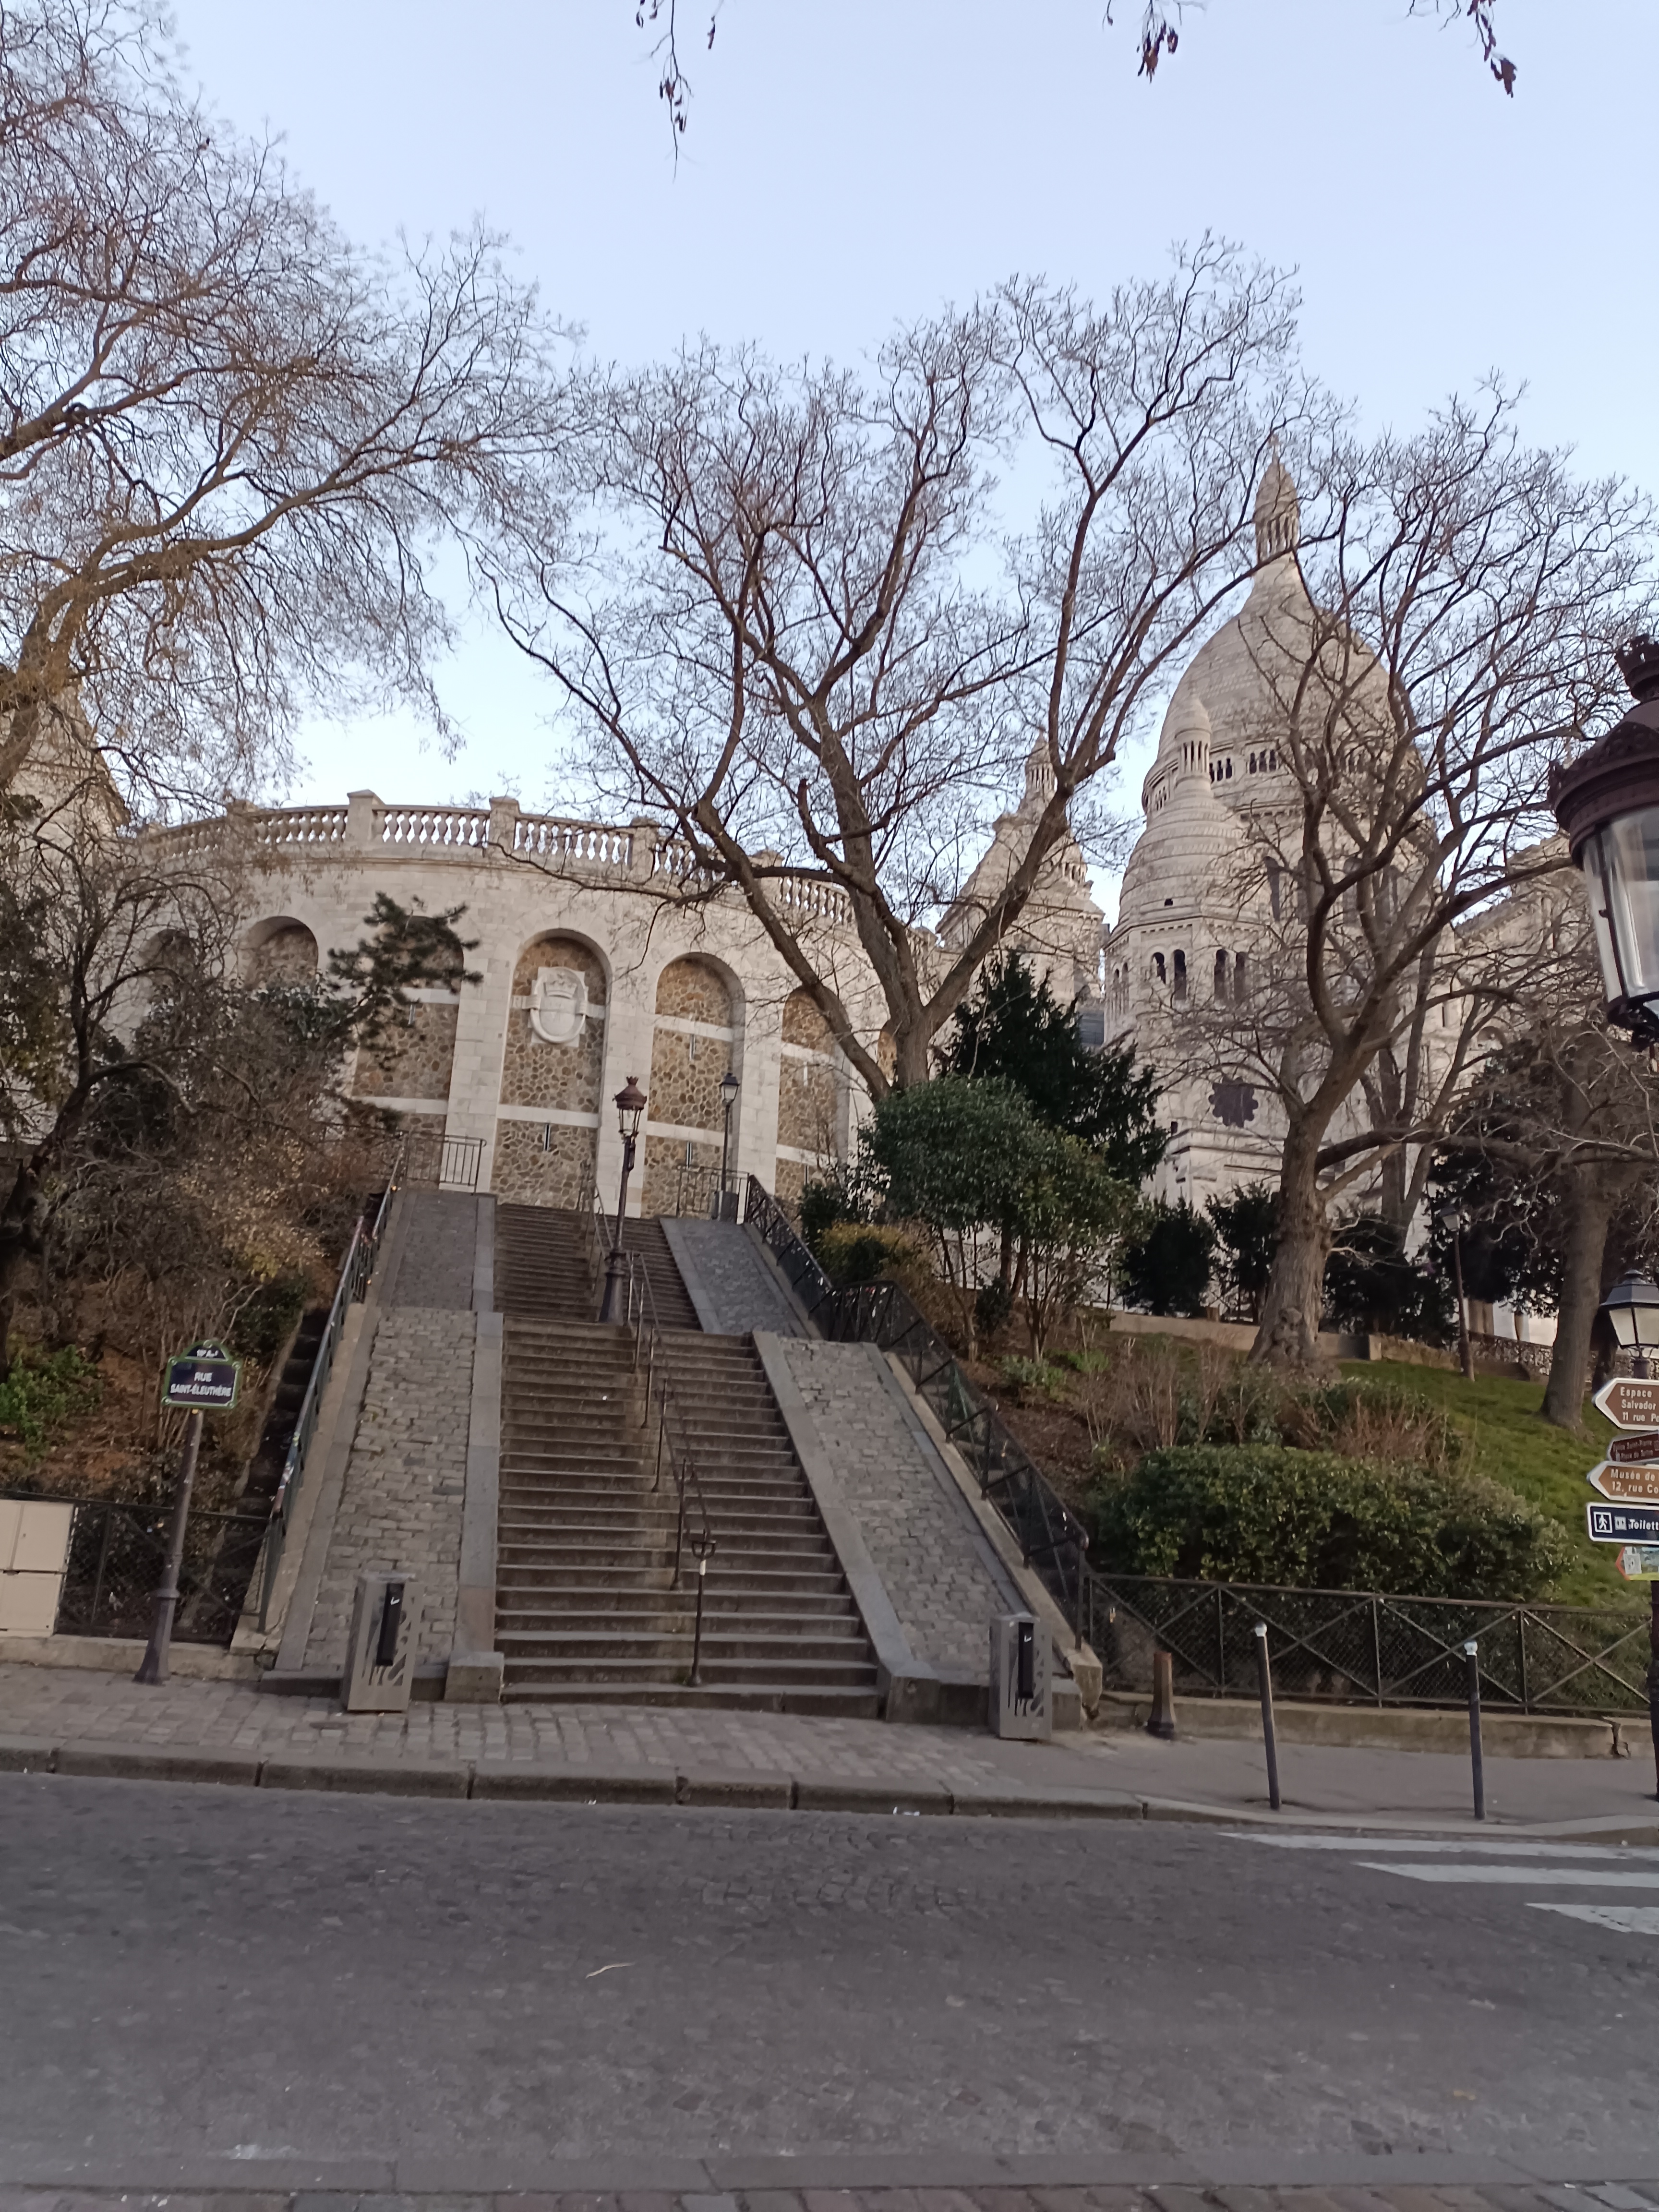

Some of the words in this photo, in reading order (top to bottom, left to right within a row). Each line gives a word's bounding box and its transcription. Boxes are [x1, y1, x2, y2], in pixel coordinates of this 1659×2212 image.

[194, 1372, 213, 1382] RUE
[1620, 1386, 1652, 1399] Espace
[1622, 1399, 1656, 1410] Salvador
[1623, 1412, 1628, 1421] 11
[1611, 1469, 1640, 1480] Musée
[1645, 1472, 1655, 1481] de
[1628, 1484, 1643, 1493] rue
